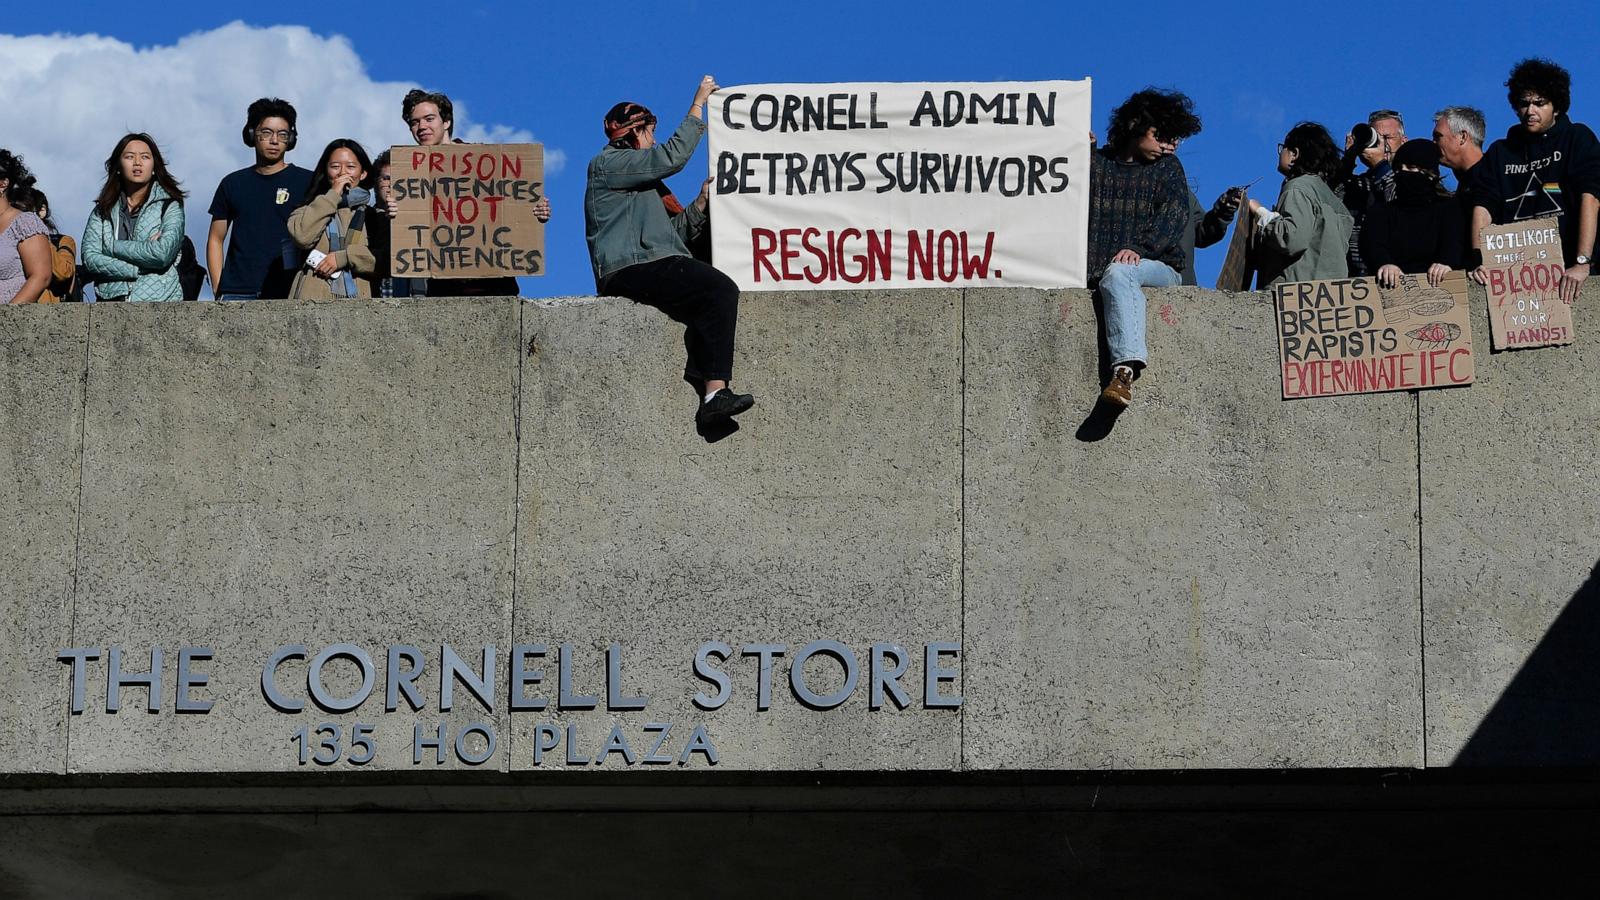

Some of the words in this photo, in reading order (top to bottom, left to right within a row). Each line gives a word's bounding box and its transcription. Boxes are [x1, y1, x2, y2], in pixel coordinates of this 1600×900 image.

[723, 92, 888, 133] CORNELL
[909, 90, 1057, 128] ADMIN
[412, 151, 522, 181] PRISON
[716, 150, 867, 195] BETRAYS
[876, 151, 1069, 197] SURVIVORS
[1505, 164, 1529, 174] PINK
[392, 177, 543, 202] SENTENCES
[432, 195, 505, 224] NOT
[408, 224, 513, 248] TOPIC
[395, 246, 543, 274] SENTENCES
[751, 227, 892, 284] RESIGN
[907, 229, 1002, 283] NOW.
[1495, 252, 1525, 264] THERE
[1536, 249, 1547, 259] IS
[1278, 278, 1370, 311] FRATS
[1489, 263, 1565, 296] BLOOD
[1280, 305, 1375, 337] BREED
[1512, 312, 1547, 326] YOUR
[1517, 299, 1539, 312] ON
[1283, 328, 1398, 362] RAPISTS
[1506, 326, 1567, 345] HANDS!
[1283, 353, 1416, 397] EXTERMINATE
[1419, 348, 1471, 387] IFC
[57, 646, 213, 714] THE
[261, 642, 648, 714] CORNELL
[693, 640, 964, 712] STORE
[291, 722, 377, 765] 135
[413, 721, 497, 764] HO
[534, 722, 719, 766] PLAZA
